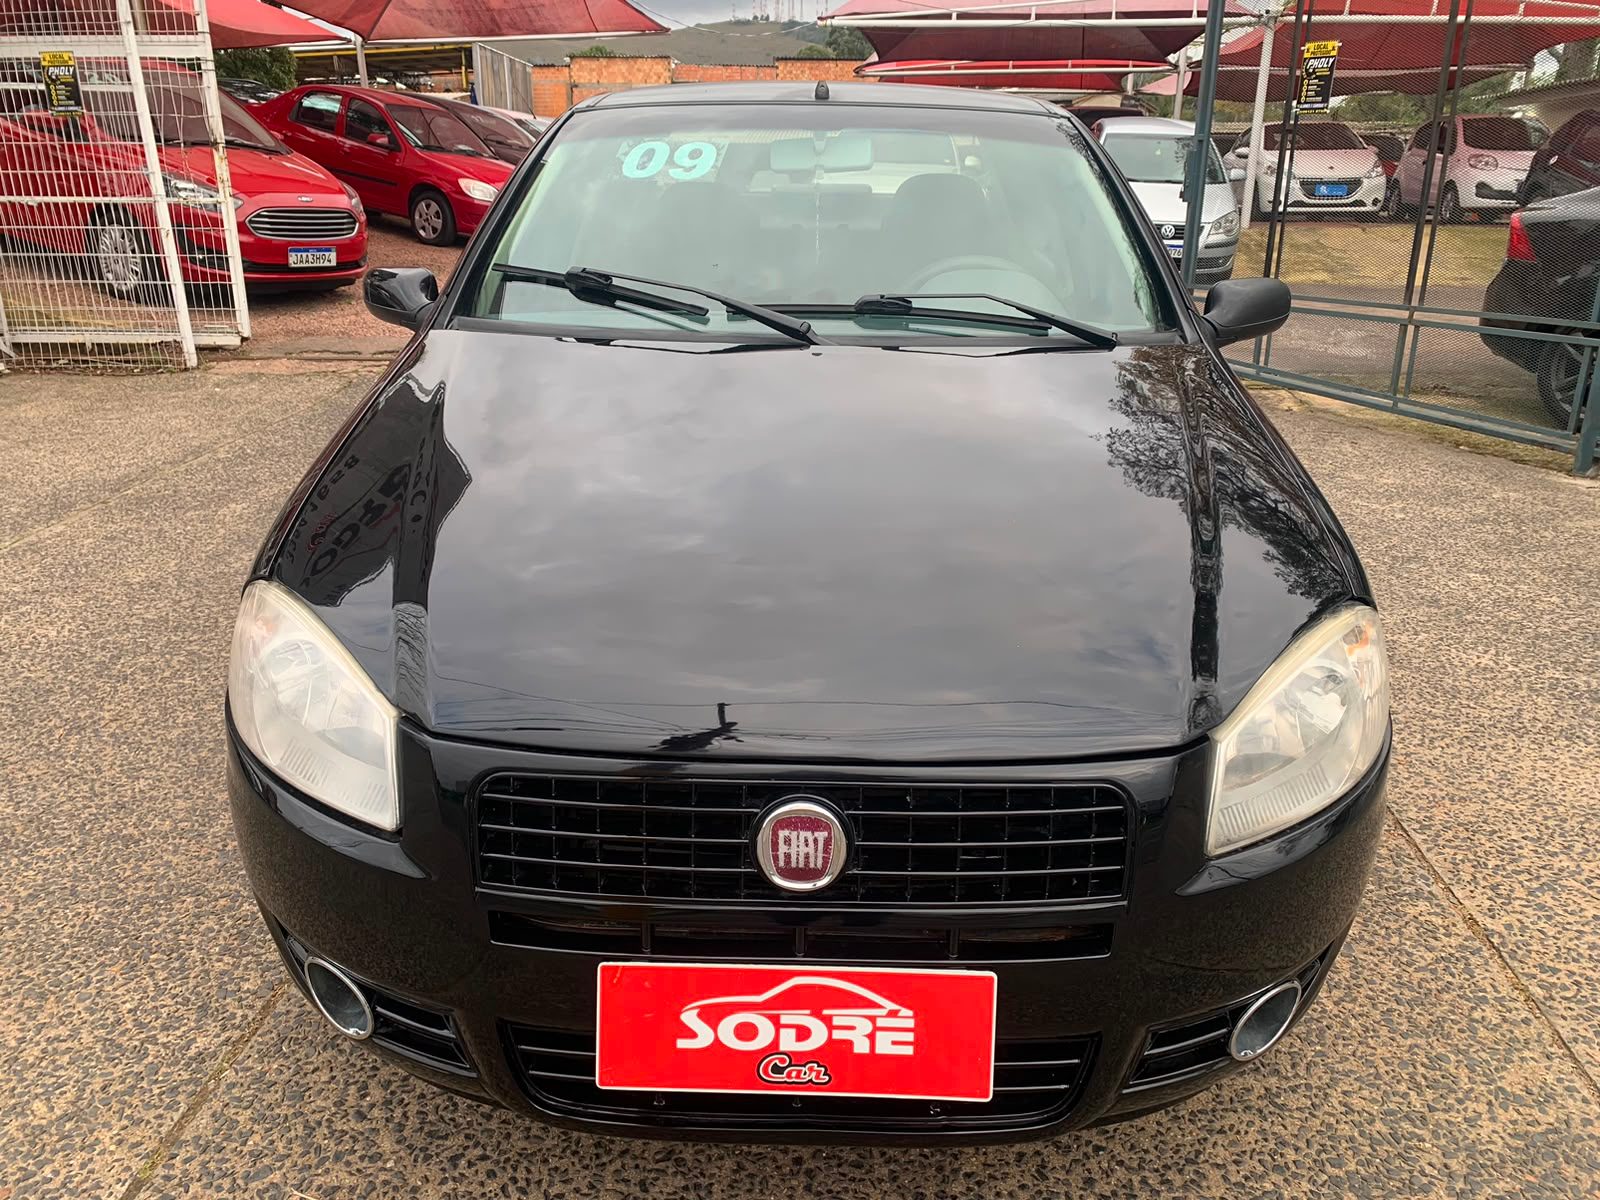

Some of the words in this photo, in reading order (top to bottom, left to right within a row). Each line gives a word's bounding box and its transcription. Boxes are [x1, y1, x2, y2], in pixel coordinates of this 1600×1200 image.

[48, 66, 74, 76] PHOLY
[1306, 57, 1335, 69] PHOLY
[622, 141, 717, 180] 09
[292, 253, 332, 265] JAA3H94
[778, 829, 828, 870] FIAT
[758, 1053, 831, 1084] Car
